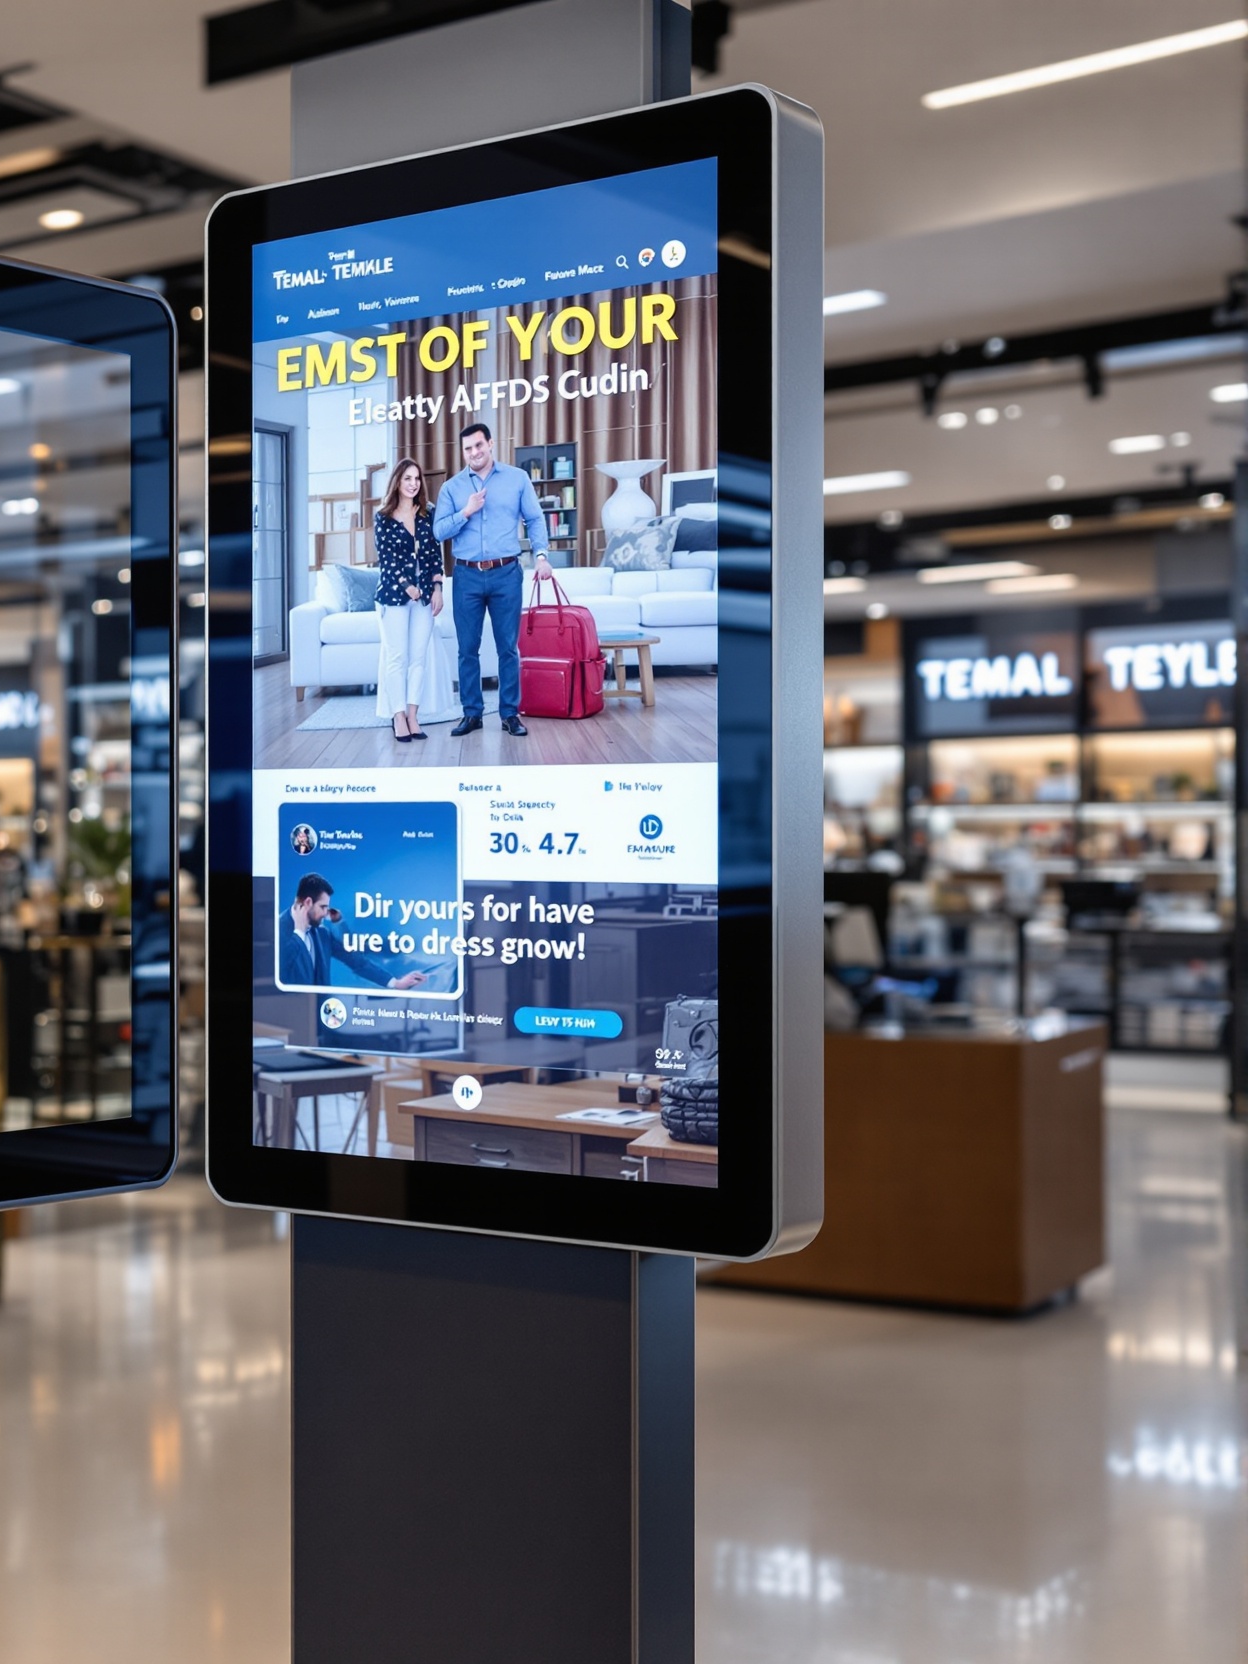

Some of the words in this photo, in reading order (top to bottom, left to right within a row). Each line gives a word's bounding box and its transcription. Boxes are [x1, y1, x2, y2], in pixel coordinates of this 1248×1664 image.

[276, 331, 407, 393] EMST
[418, 319, 491, 373] OF
[506, 293, 680, 361] YOUR
[450, 374, 550, 414] AFFDS
[557, 362, 650, 400] Cudin
[917, 652, 1073, 700] TEMAL
[489, 832, 519, 854] 30
[538, 832, 580, 855] 4.7
[354, 892, 393, 919] Dir
[399, 898, 475, 925] yours
[481, 894, 522, 922] for
[529, 895, 595, 924] have
[342, 931, 383, 953] ure
[387, 930, 416, 954] to
[421, 928, 495, 957] dress
[500, 932, 586, 965] gnow!
